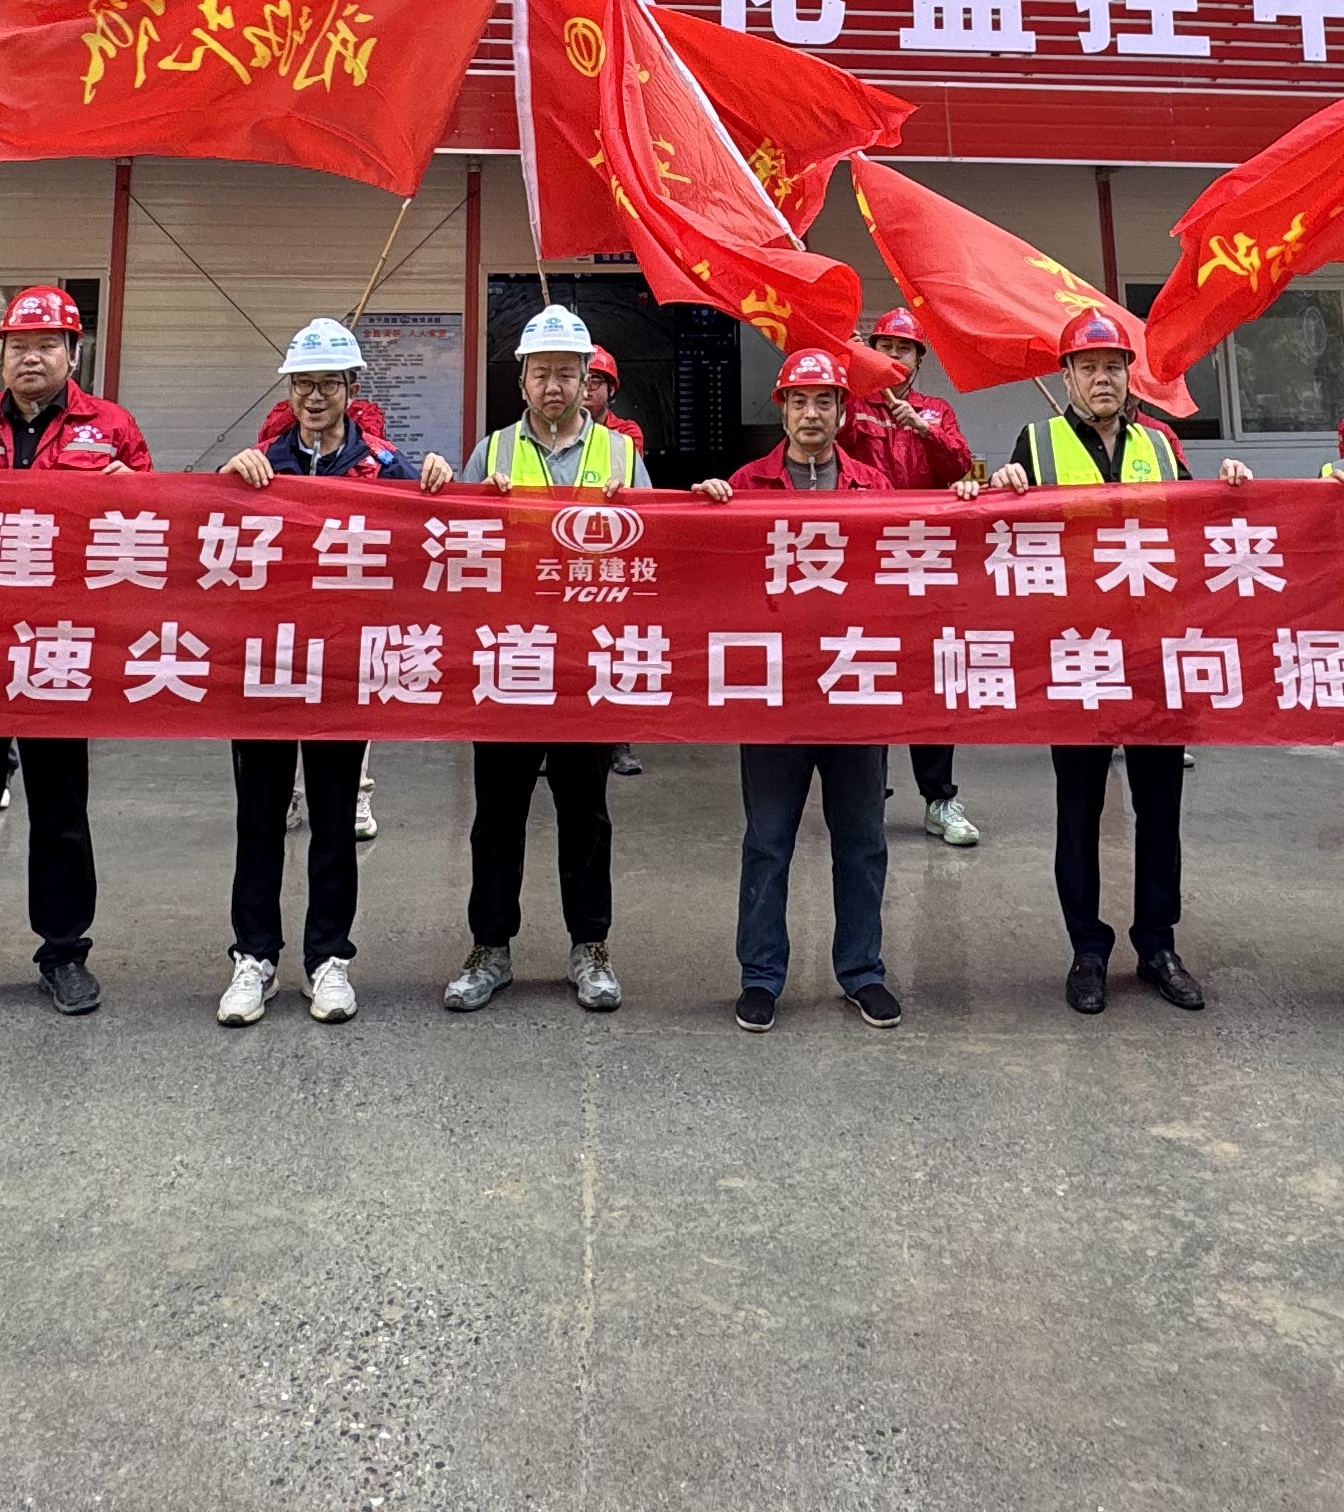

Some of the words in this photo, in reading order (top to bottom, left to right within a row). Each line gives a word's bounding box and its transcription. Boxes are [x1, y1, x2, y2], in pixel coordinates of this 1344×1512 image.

[764, 517, 1288, 598] 投幸福未来
[535, 558, 658, 583] 云南建投
[561, 587, 631, 603] YCIH
